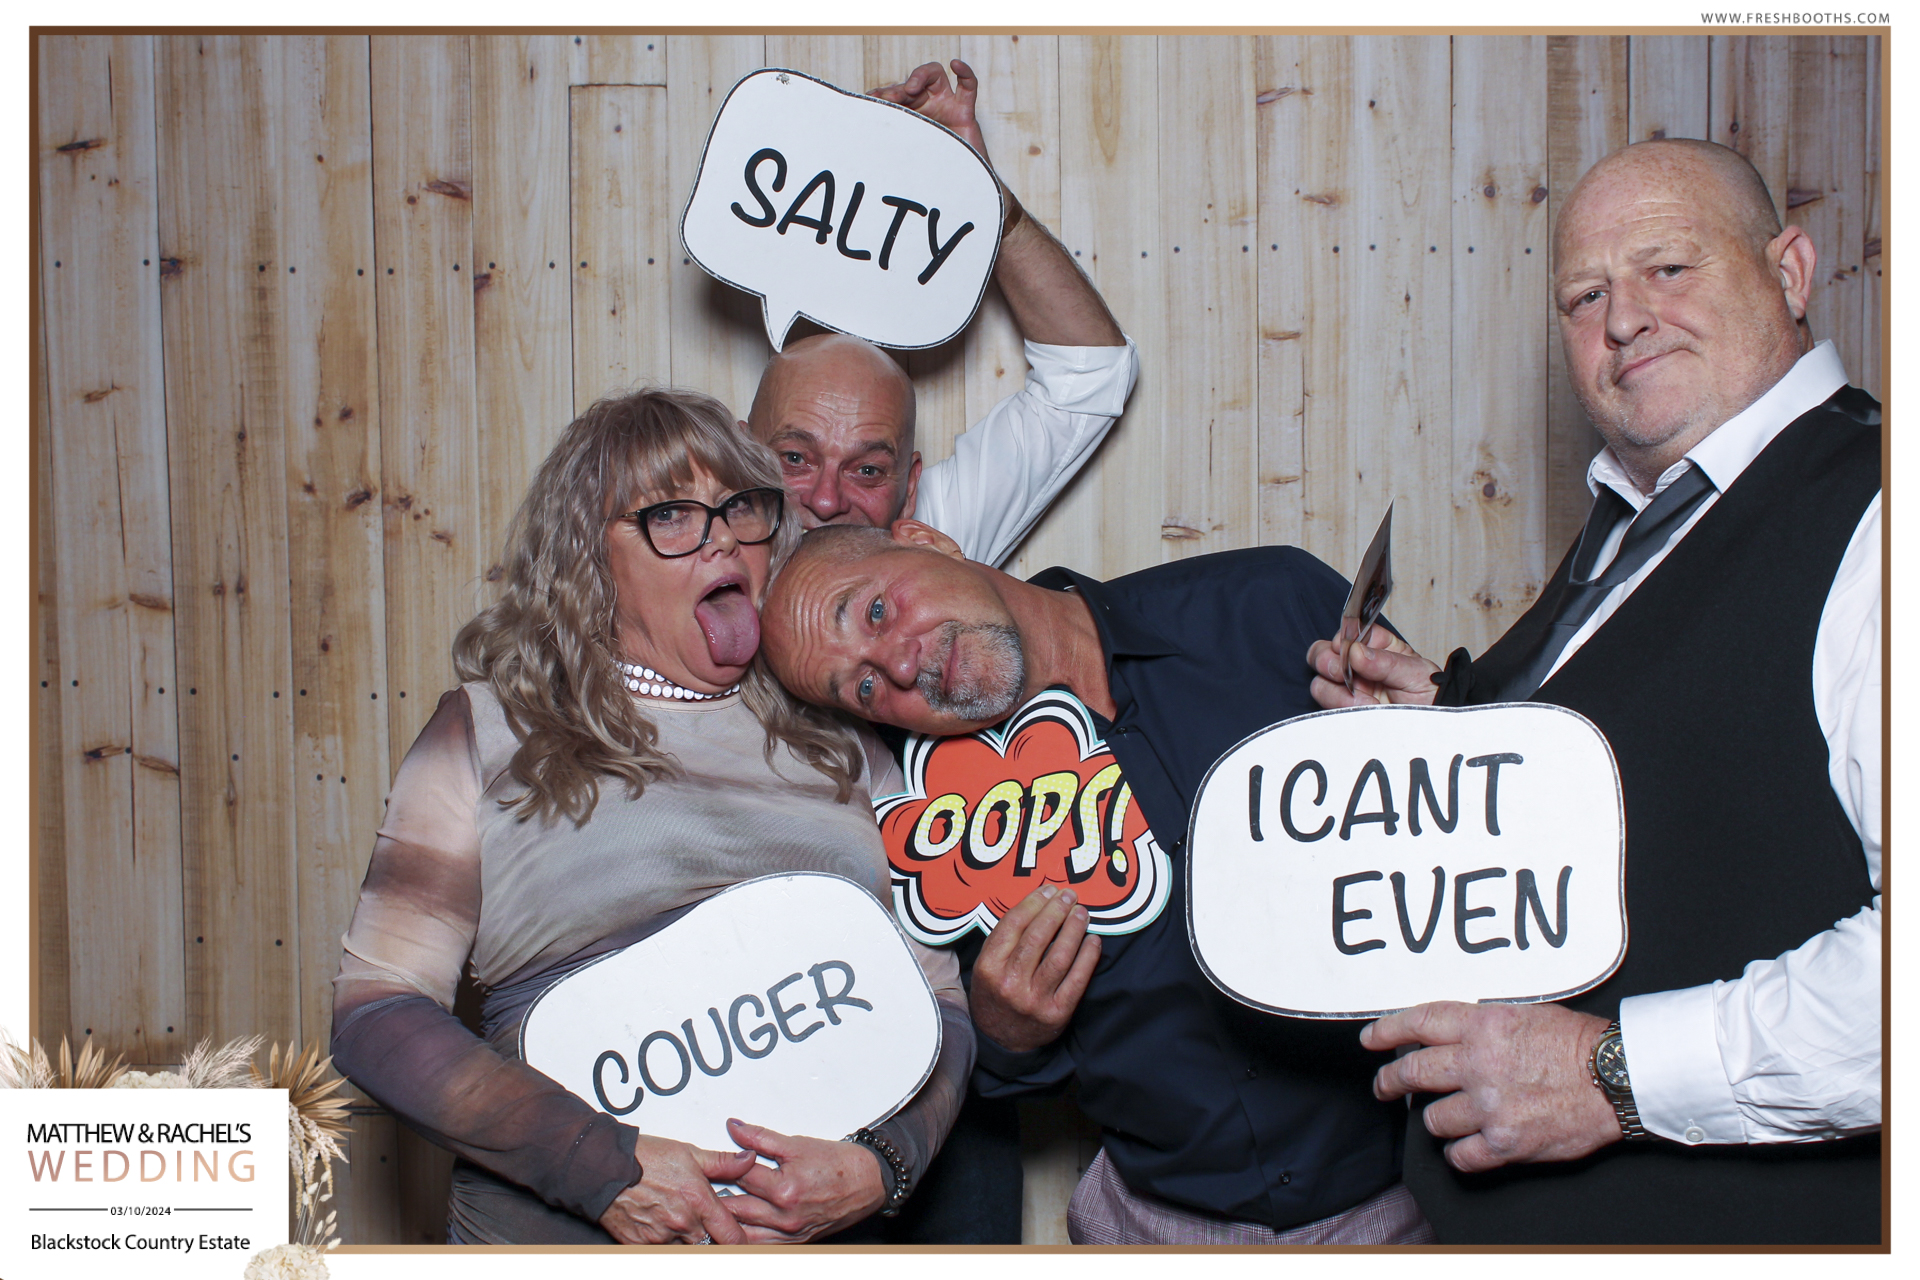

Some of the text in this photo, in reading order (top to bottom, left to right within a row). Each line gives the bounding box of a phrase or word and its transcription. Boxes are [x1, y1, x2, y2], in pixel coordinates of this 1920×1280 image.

[730, 147, 975, 286] SALTY
[906, 762, 1133, 886] OOPS!
[1332, 865, 1573, 956] EVEN
[592, 959, 874, 1116] COUGER
